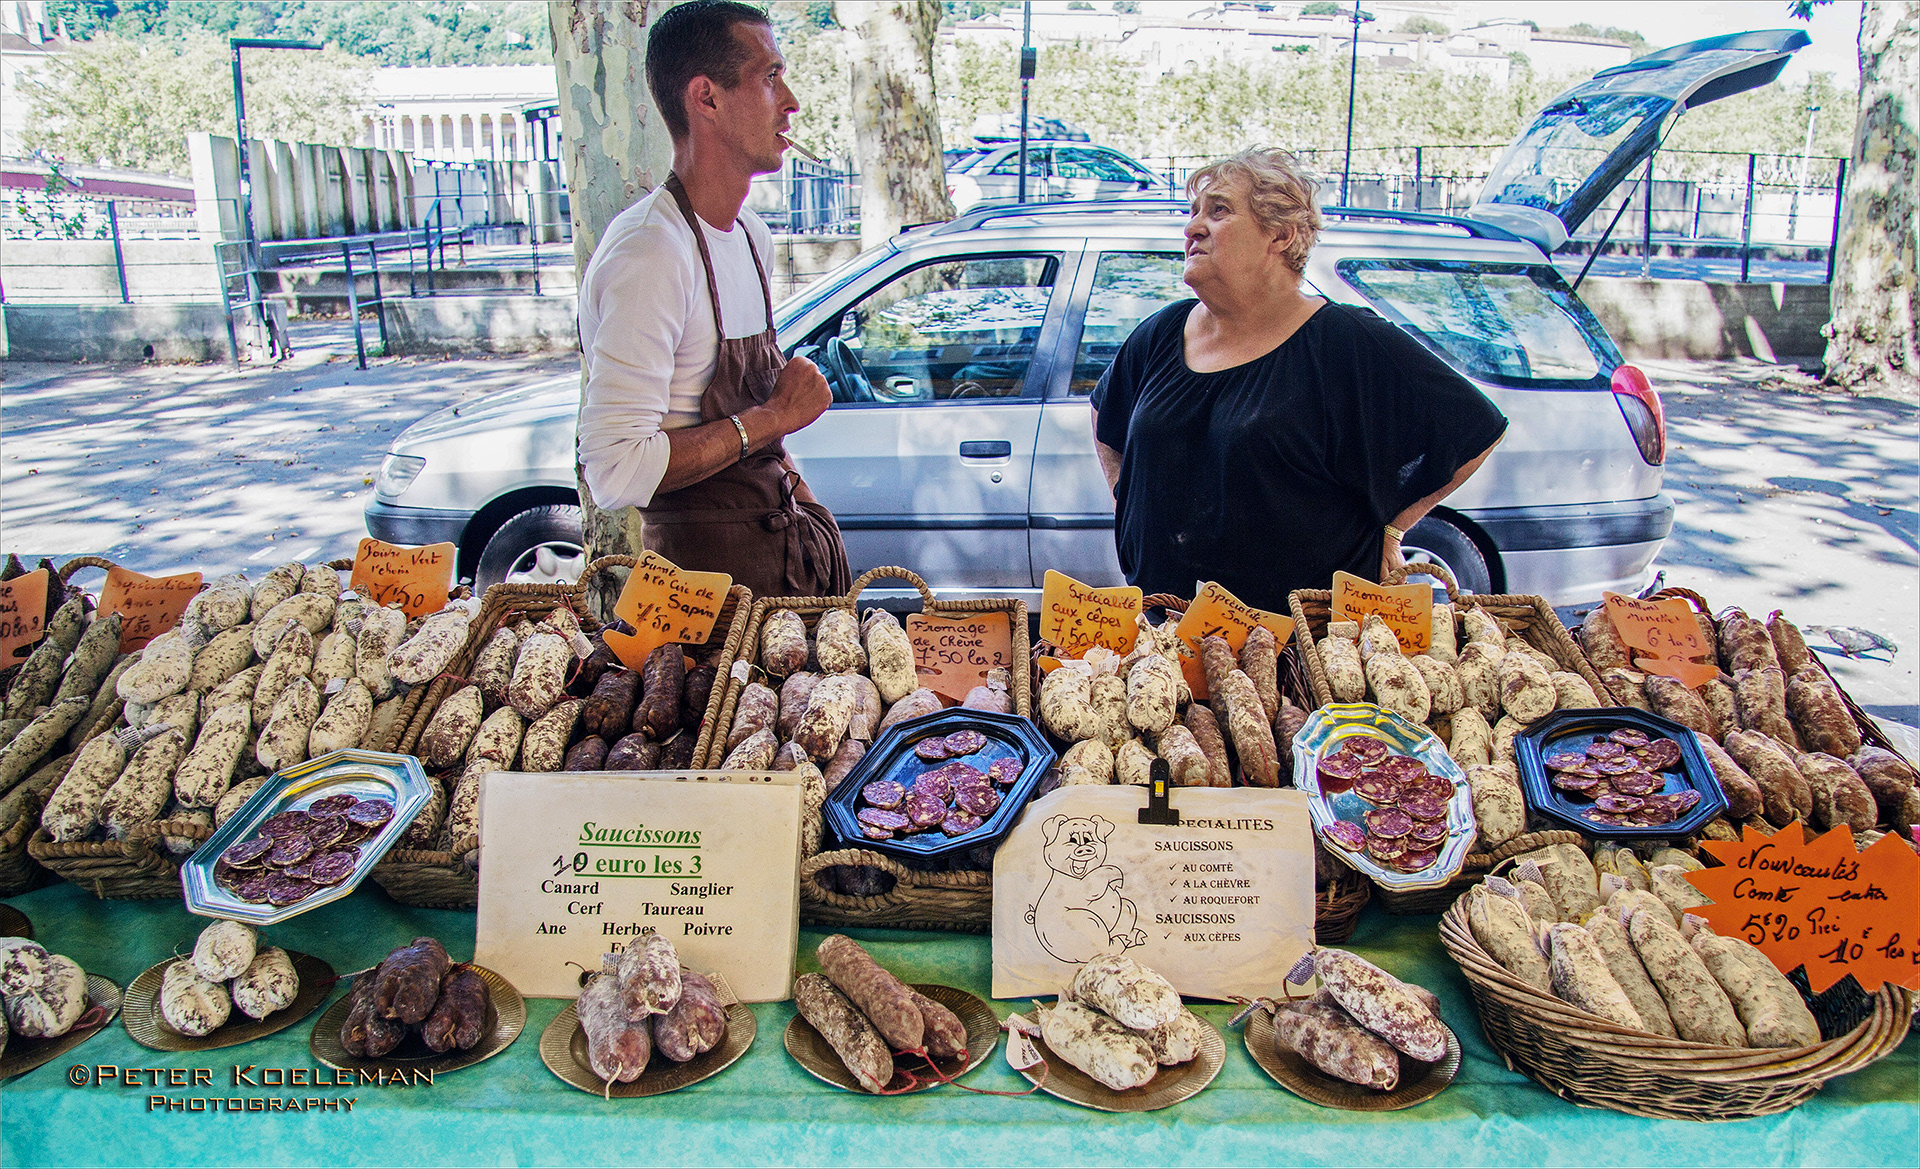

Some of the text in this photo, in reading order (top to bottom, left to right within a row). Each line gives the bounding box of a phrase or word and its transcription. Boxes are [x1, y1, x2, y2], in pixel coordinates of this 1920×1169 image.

[411, 549, 442, 565] Vert
[695, 587, 714, 600] de
[1069, 584, 1137, 609] Spécialité
[1343, 581, 1413, 612] Fromage
[668, 593, 715, 619] Sapin
[1345, 604, 1364, 615] au
[1051, 603, 1121, 629] aux cêpes
[911, 621, 988, 638] Fromage
[913, 634, 984, 647] de Chèvre
[1091, 630, 1112, 650] les
[1114, 636, 1131, 655] 2
[1394, 629, 1427, 649] les 2
[968, 649, 989, 665] les
[993, 652, 1012, 666] 2
[578, 821, 702, 844] Saucissons
[1166, 819, 1274, 831] PECIALITES
[1154, 841, 1233, 852] SAUCISSONS
[596, 857, 646, 874] euro
[653, 855, 683, 874] les
[689, 855, 702, 875] 3
[1182, 862, 1233, 873] AU COMTÉ
[541, 879, 734, 899] Canard Sanglier
[1183, 878, 1250, 888] A LA CHÈVRE
[567, 901, 704, 916] Cerf Taureau
[1183, 896, 1260, 905] AU ROQUEFORT
[1155, 913, 1236, 924] SAUCISSONS
[536, 921, 734, 936] Ane Herbes Poivre
[1184, 931, 1241, 941] AUX CÈPES
[1876, 932, 1904, 959] les
